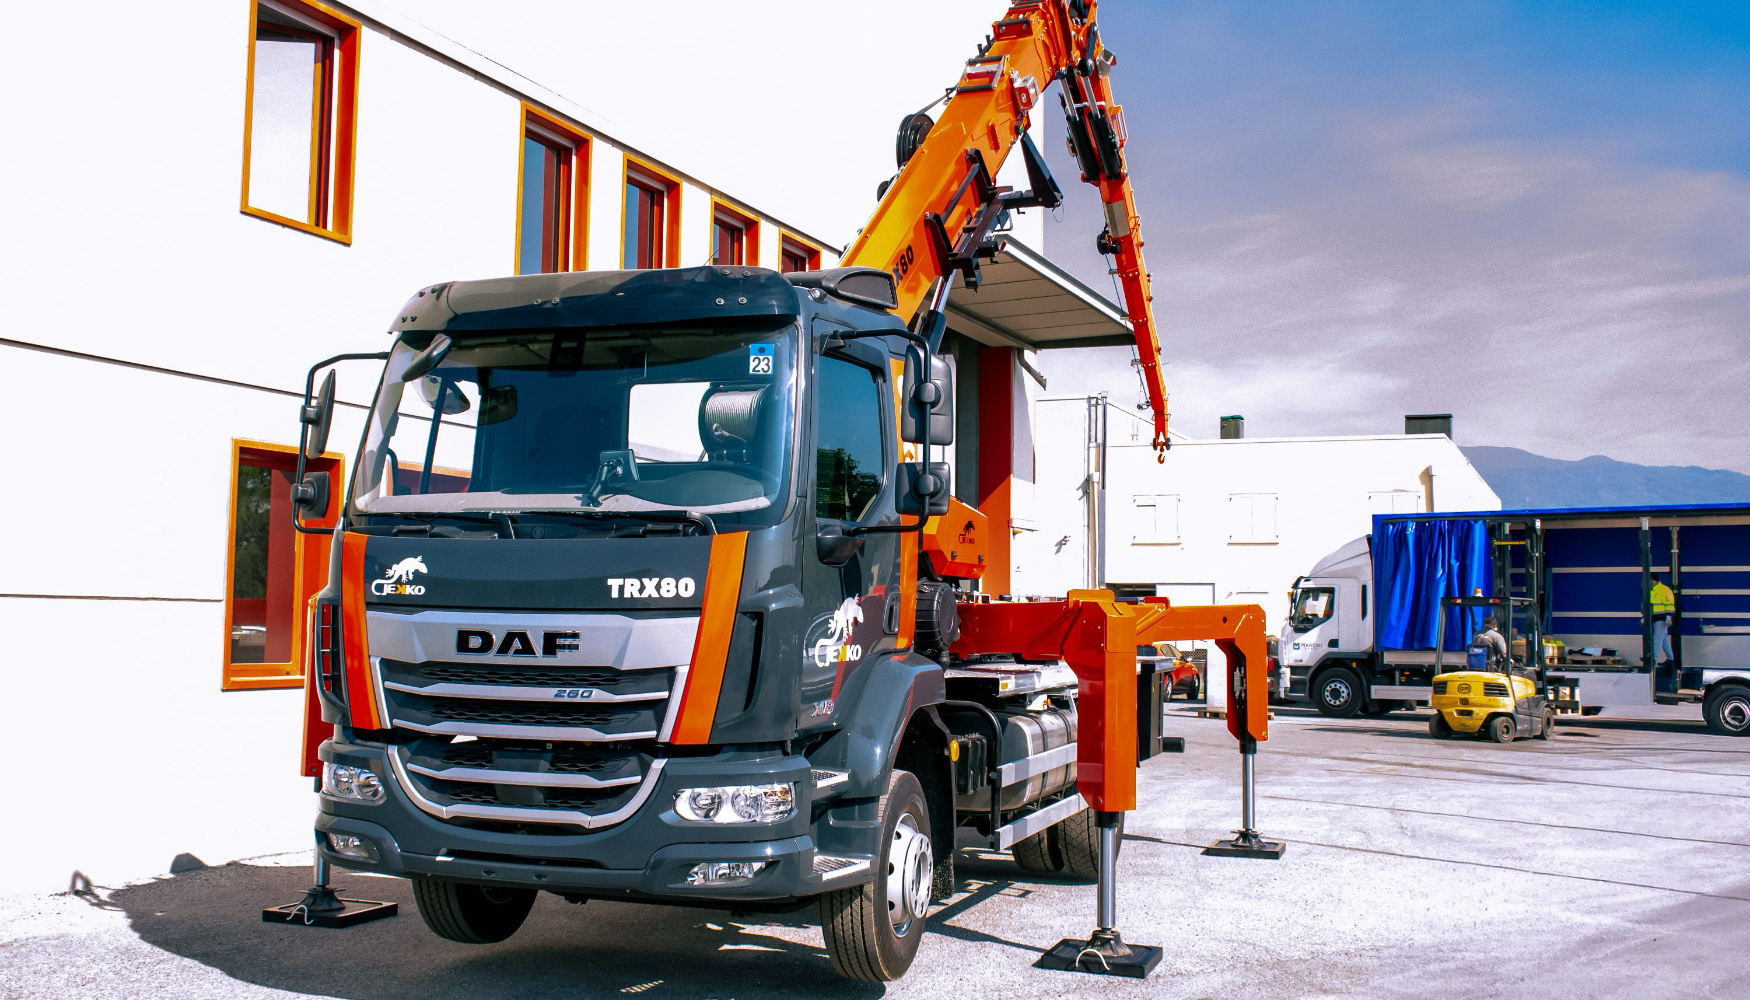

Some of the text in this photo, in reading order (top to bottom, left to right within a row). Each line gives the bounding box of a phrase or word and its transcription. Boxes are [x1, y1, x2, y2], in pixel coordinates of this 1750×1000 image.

[751, 356, 771, 374] 23
[607, 577, 696, 598] TRX80
[456, 628, 582, 658] DAF
[553, 689, 594, 699] 260
